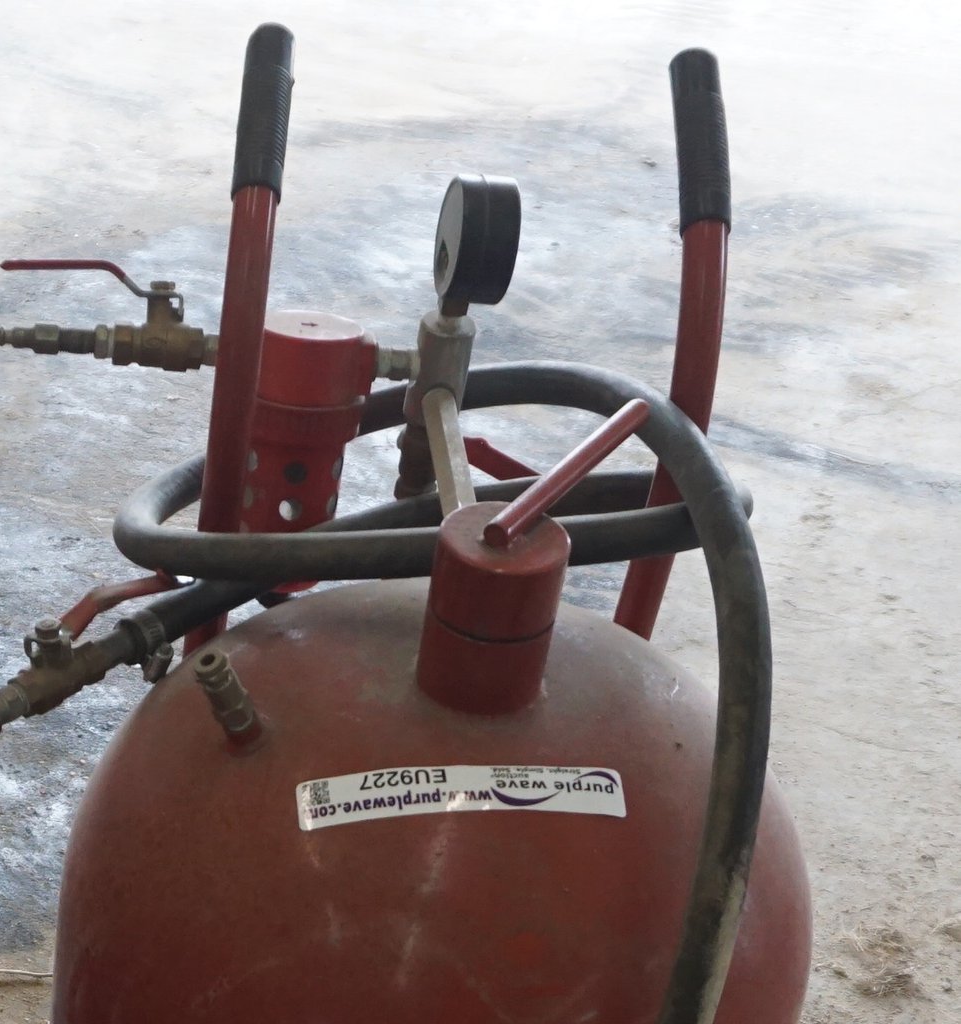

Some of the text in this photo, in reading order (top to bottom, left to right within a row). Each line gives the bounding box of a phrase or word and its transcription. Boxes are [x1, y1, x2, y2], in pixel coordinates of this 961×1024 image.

[359, 769, 447, 791] EU9227
[495, 778, 615, 795] purple wave
